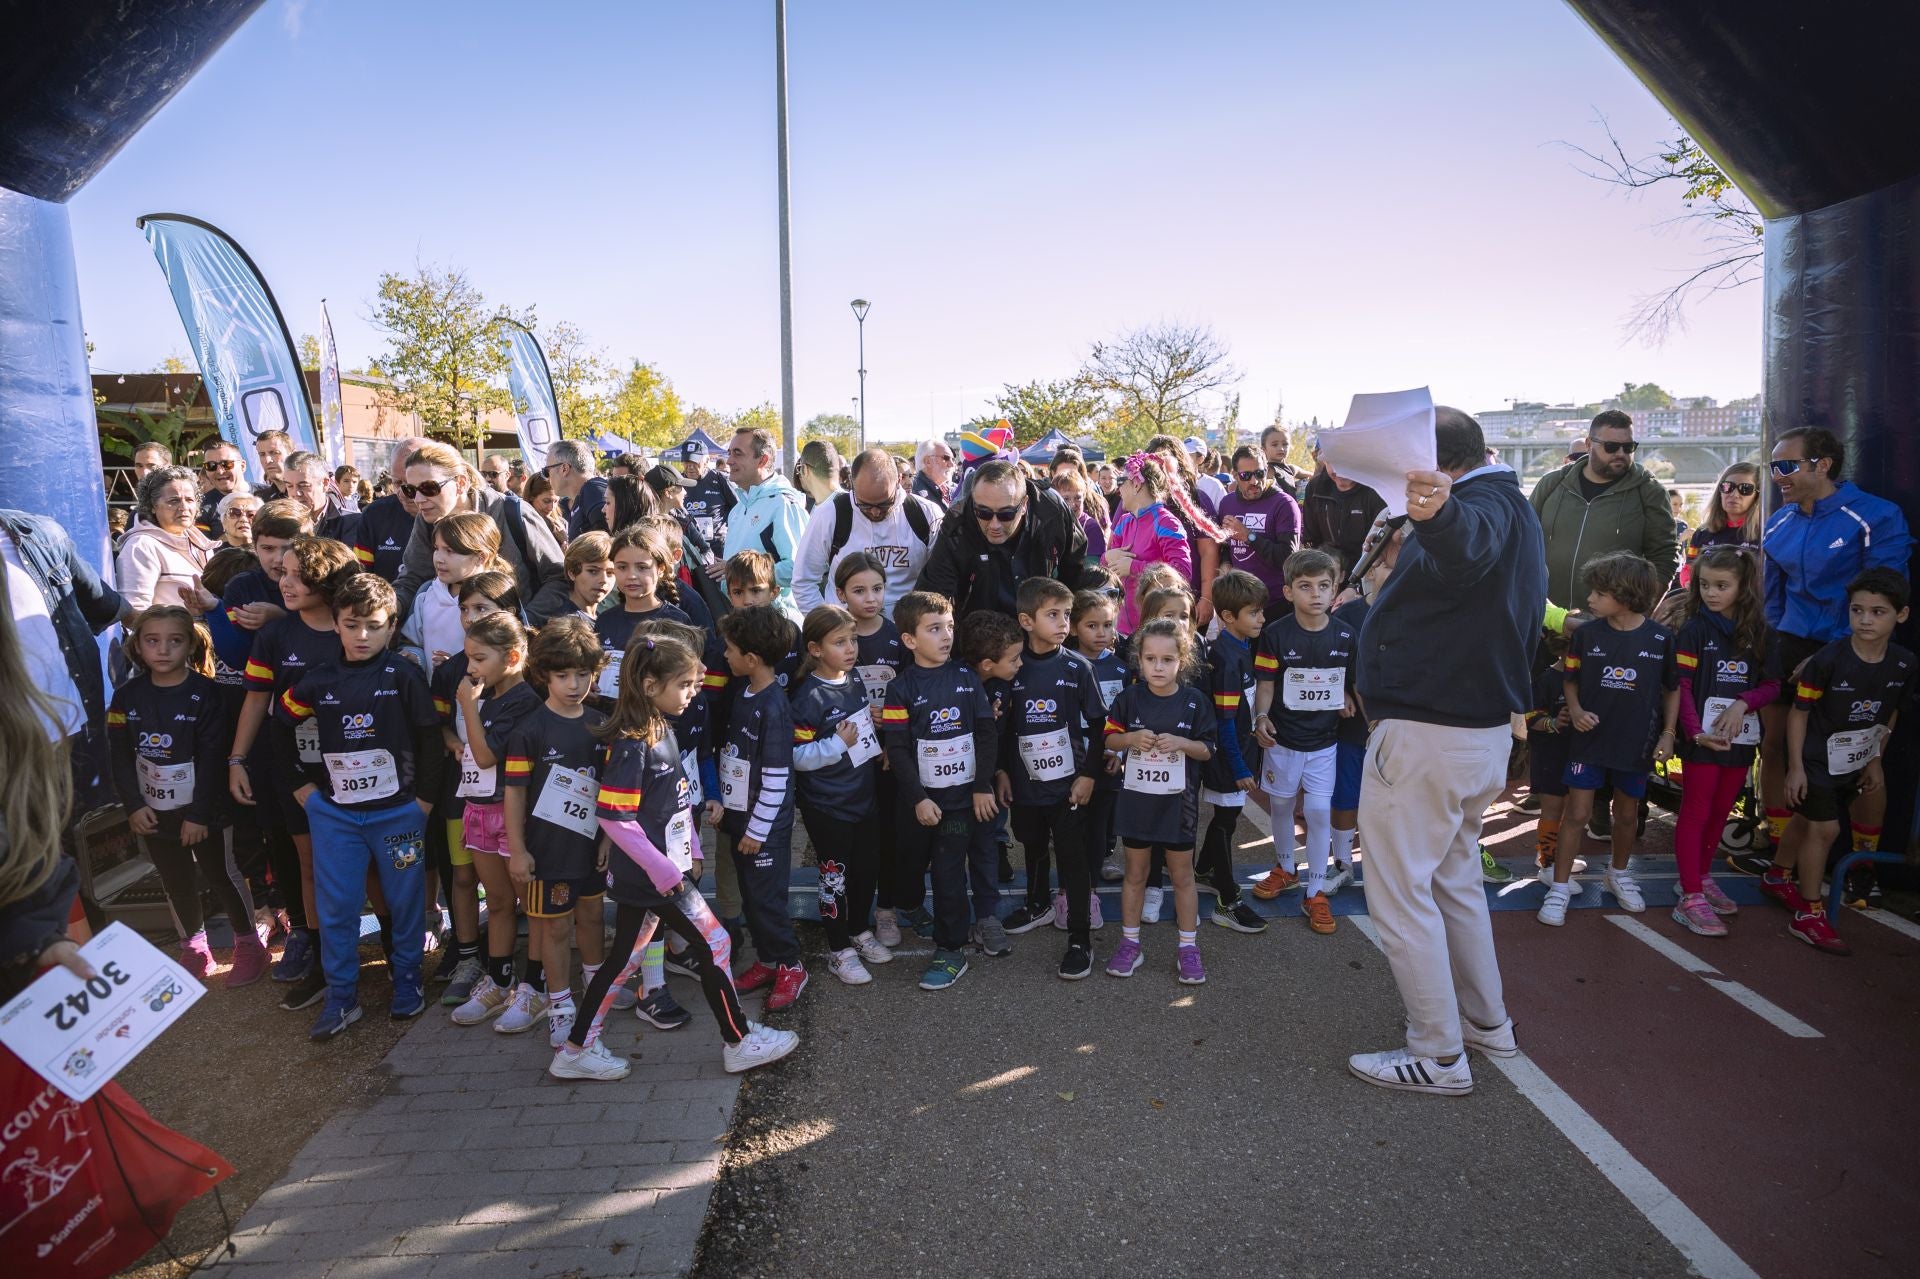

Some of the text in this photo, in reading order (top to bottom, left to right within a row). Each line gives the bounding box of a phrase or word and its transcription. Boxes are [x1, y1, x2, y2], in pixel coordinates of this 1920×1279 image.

[1602, 666, 1637, 681] 200
[1717, 660, 1748, 674] 200
[1299, 690, 1331, 701] 3073
[1025, 699, 1057, 714] 200
[342, 713, 374, 730] 200
[929, 706, 961, 725] 200
[139, 731, 173, 748] 200
[934, 761, 966, 777] 3054
[1032, 755, 1064, 771] 3069
[341, 775, 378, 792] 3037
[1137, 768, 1170, 782] 3120
[144, 783, 175, 800] 3081
[563, 800, 589, 820] 126
[384, 829, 421, 846] SONIC
[43, 960, 132, 1031] 3042
[95, 1005, 137, 1042] Santander
